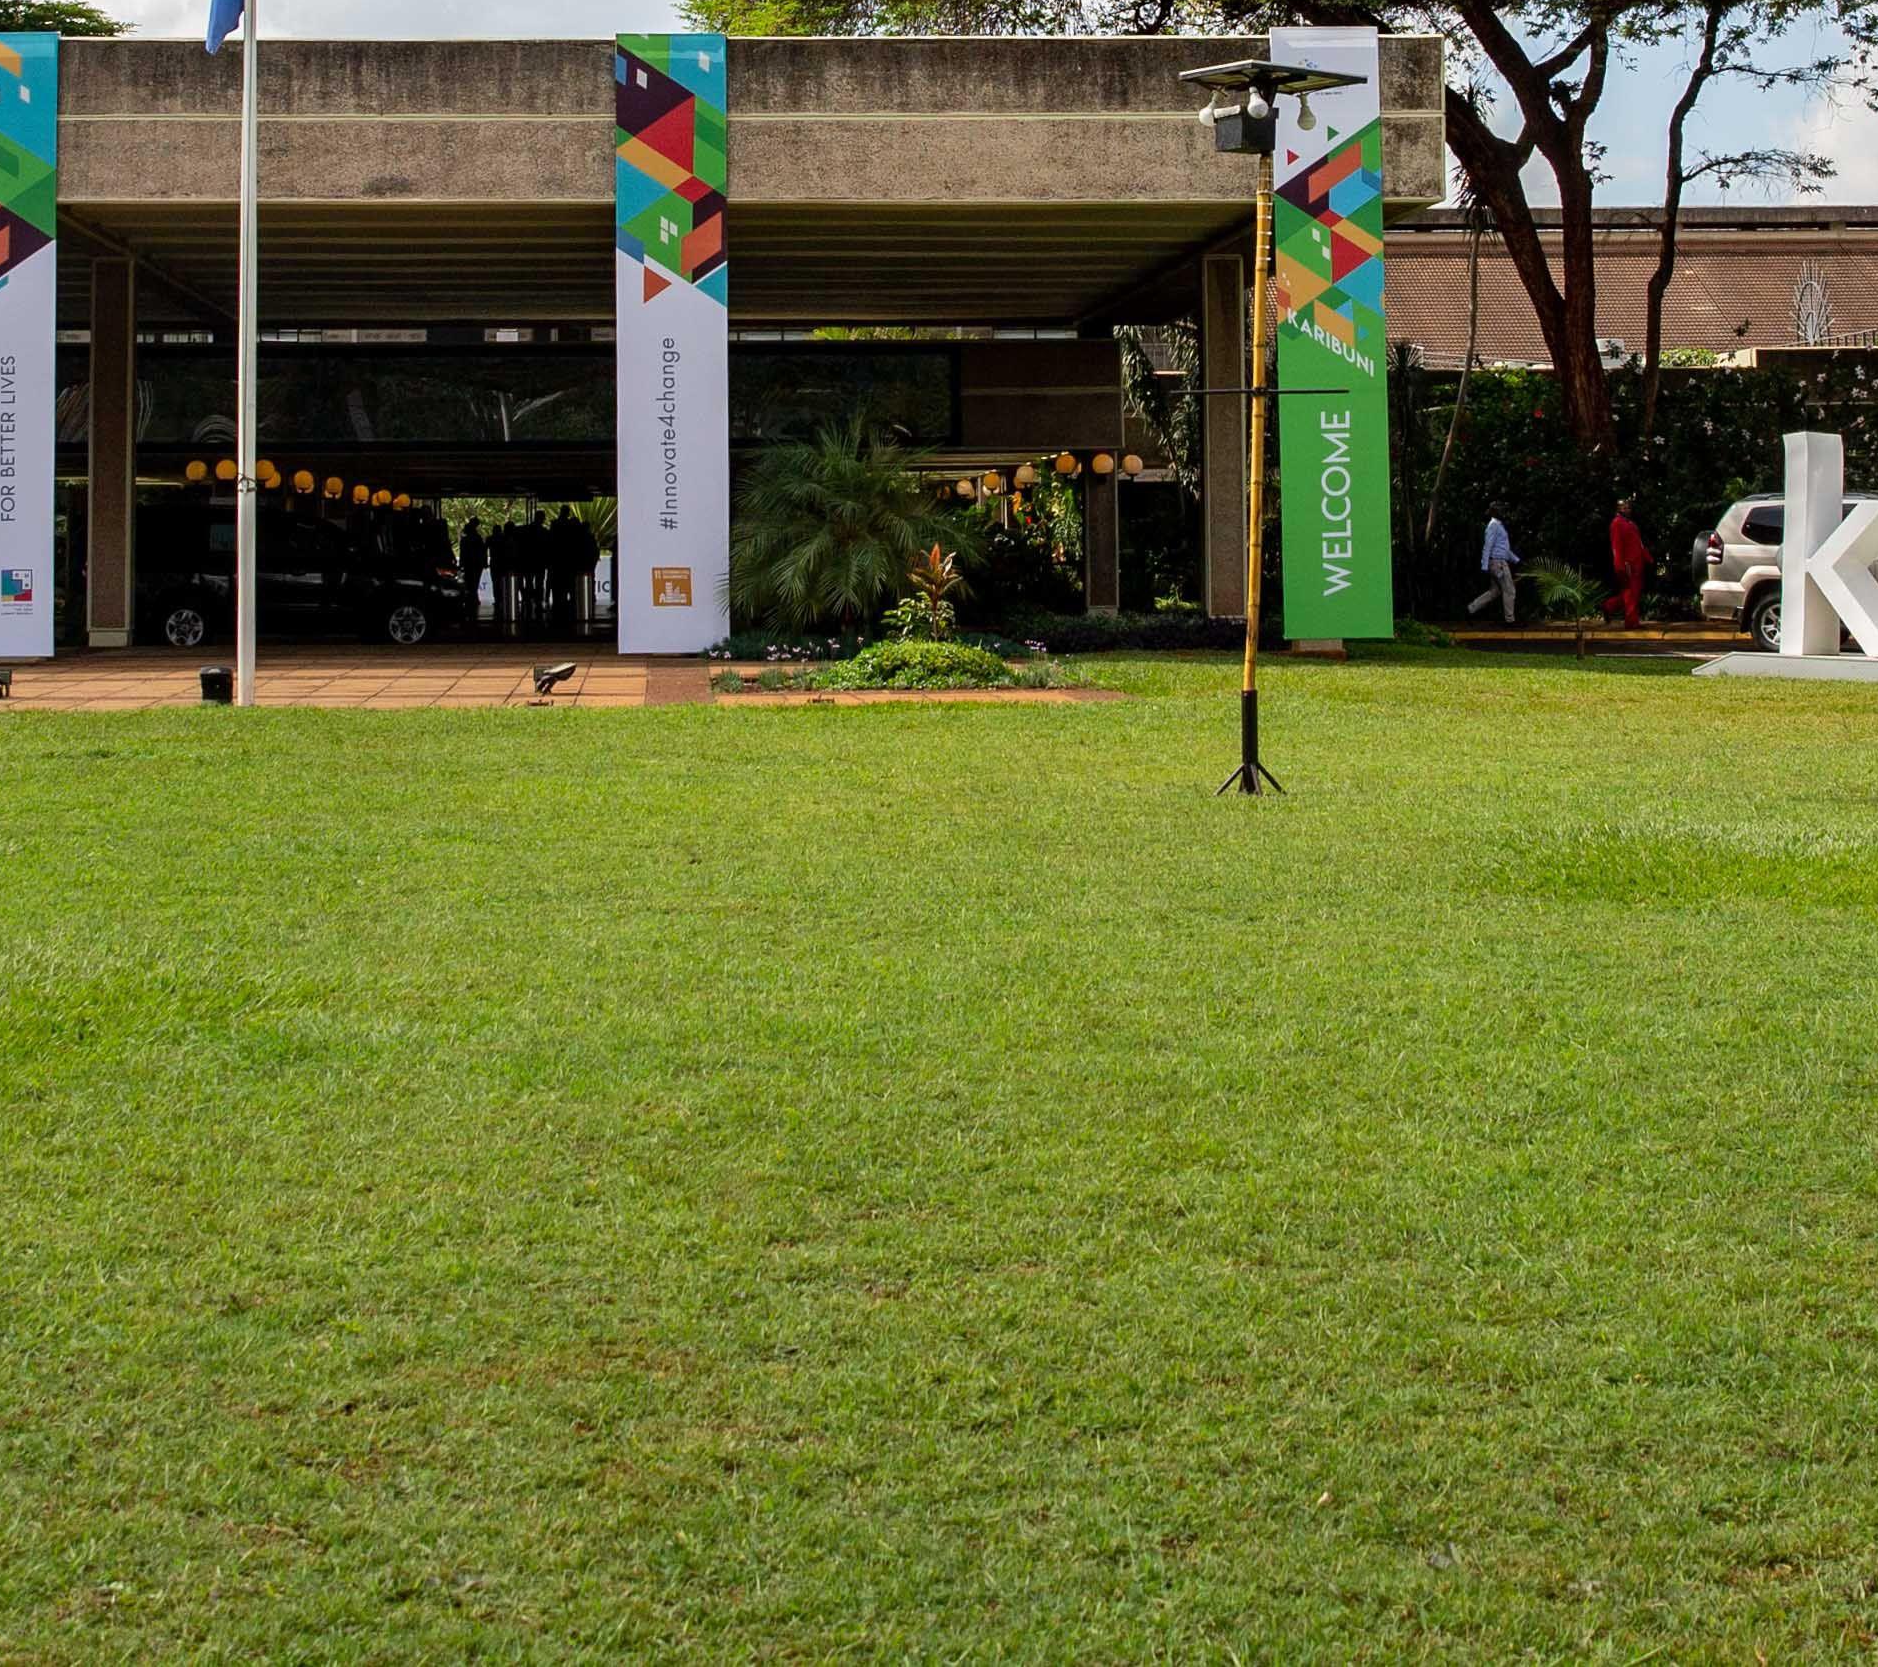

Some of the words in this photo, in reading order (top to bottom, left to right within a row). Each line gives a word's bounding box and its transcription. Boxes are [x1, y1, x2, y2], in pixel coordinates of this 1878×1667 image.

[1287, 307, 1374, 377] KARIBUNI
[1, 355, 16, 404] LIVES
[1, 412, 16, 477] BETTER
[656, 337, 680, 530] #Innovate4change
[1, 485, 16, 522] FOR
[1320, 410, 1352, 597] WELCOME
